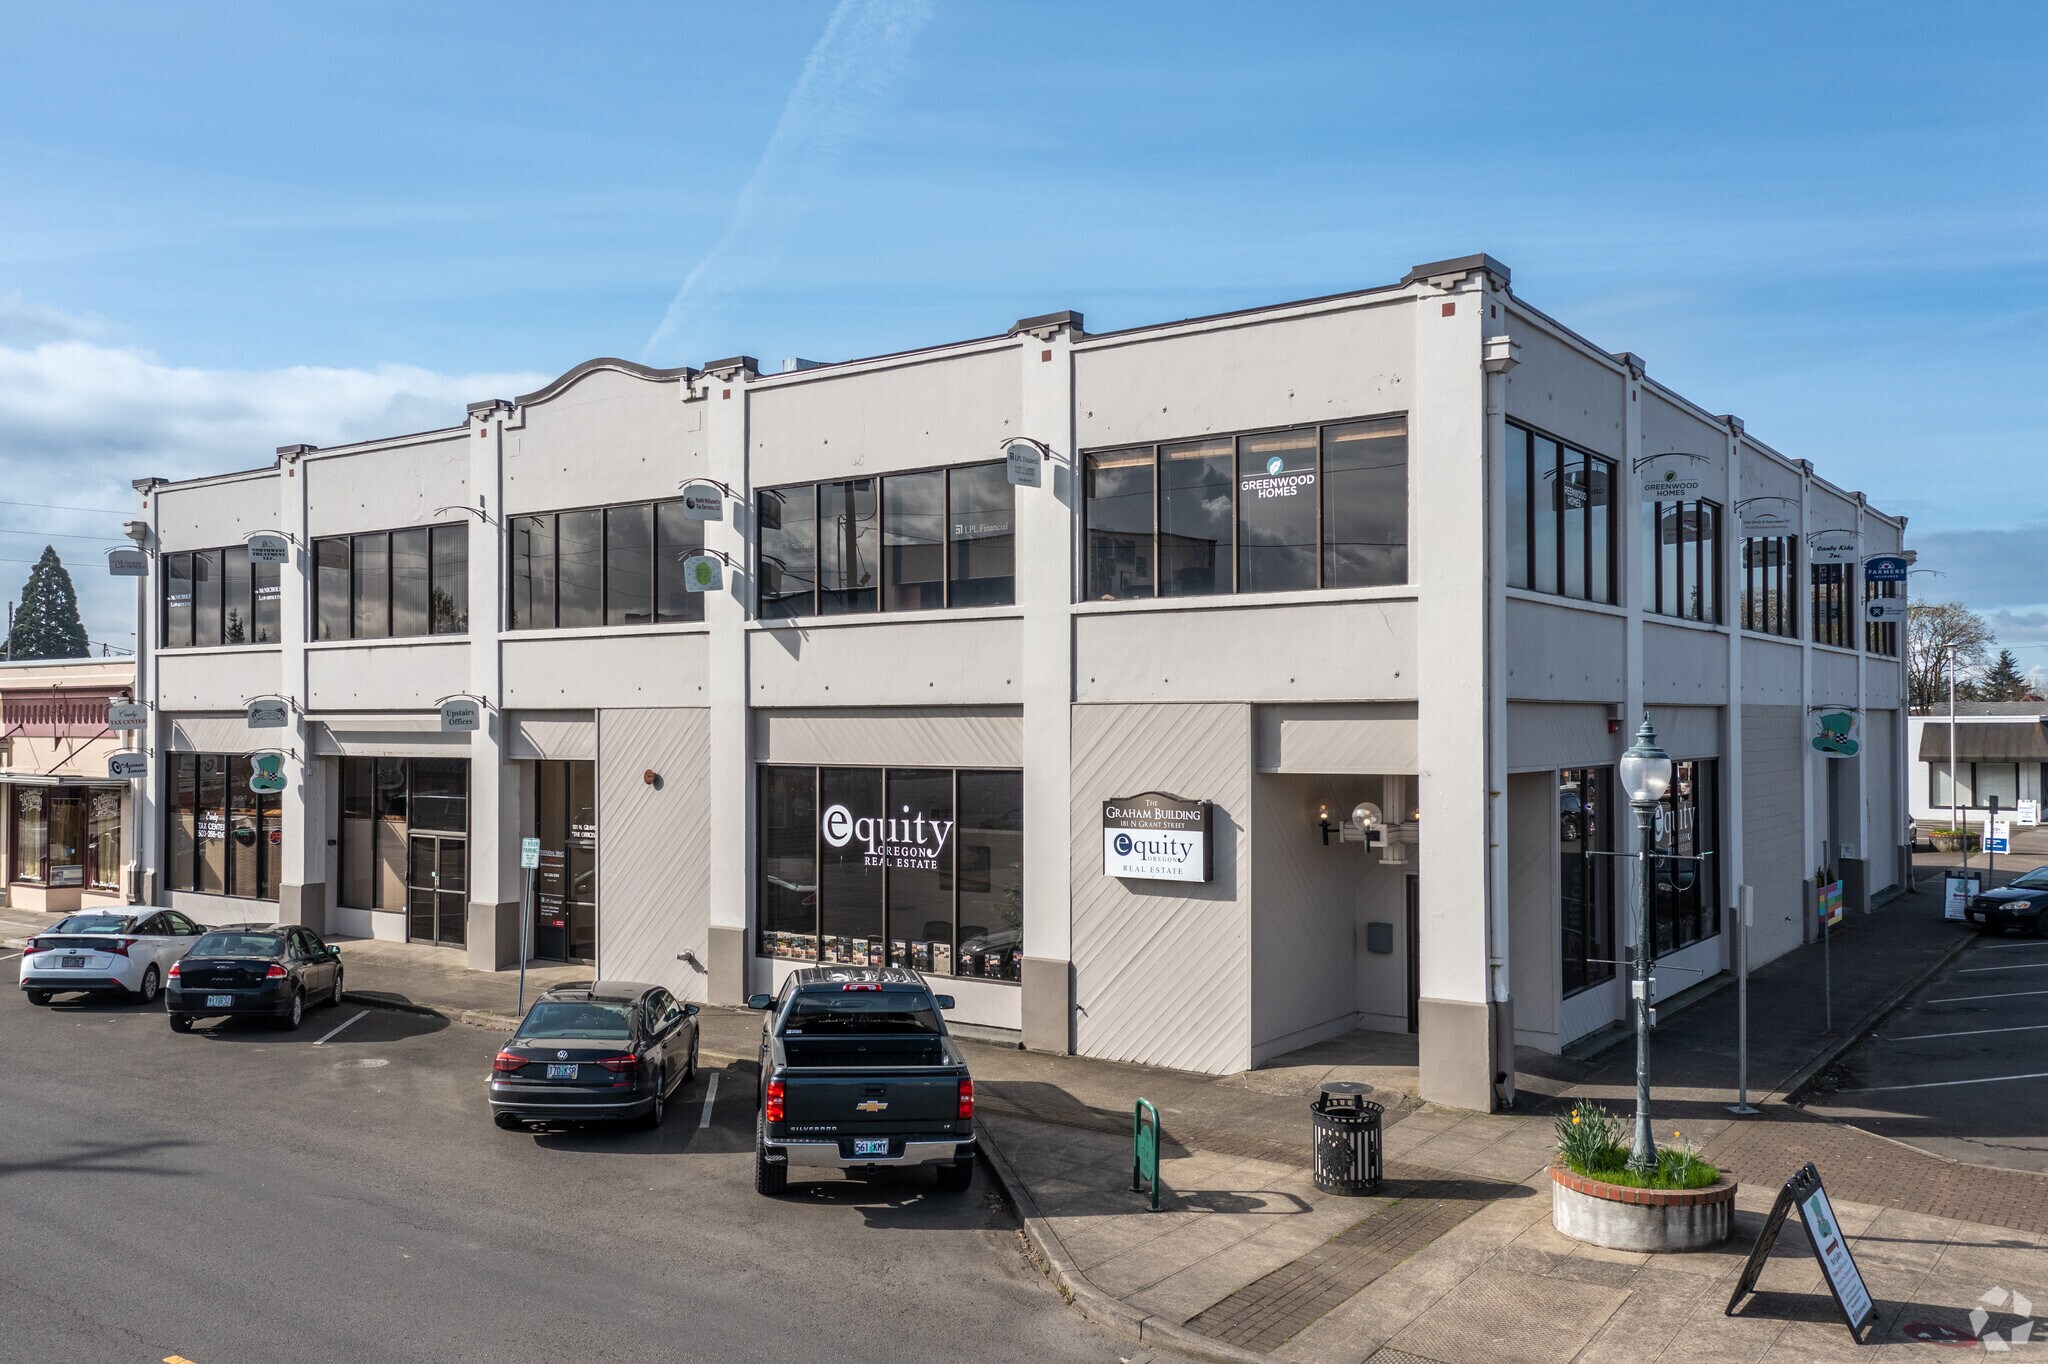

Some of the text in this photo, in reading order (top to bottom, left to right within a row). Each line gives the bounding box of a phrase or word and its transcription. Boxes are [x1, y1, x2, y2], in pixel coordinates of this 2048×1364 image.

[1241, 474, 1315, 491] GREENWOOD
[1644, 482, 1699, 491] GREENWOOD
[1258, 486, 1298, 499] HOMES
[1564, 485, 1588, 501] REENWOOD
[1656, 489, 1686, 497] HOMES
[964, 521, 1008, 534] LPL Financial
[446, 709, 475, 719] Upstairs
[448, 718, 473, 726] Offices
[1105, 806, 1201, 821] GRAHAM BUILDING
[822, 804, 954, 858] equity
[1138, 820, 1161, 828] GRANT
[1163, 821, 1185, 829] STREET
[877, 845, 926, 858] OREGON
[1113, 832, 1194, 863] equity
[864, 856, 938, 870] REAL ESTATE
[1147, 855, 1178, 863] OREGON
[1122, 864, 1183, 875] REAL ESTATE
[855, 1140, 887, 1153] 561 KMY
